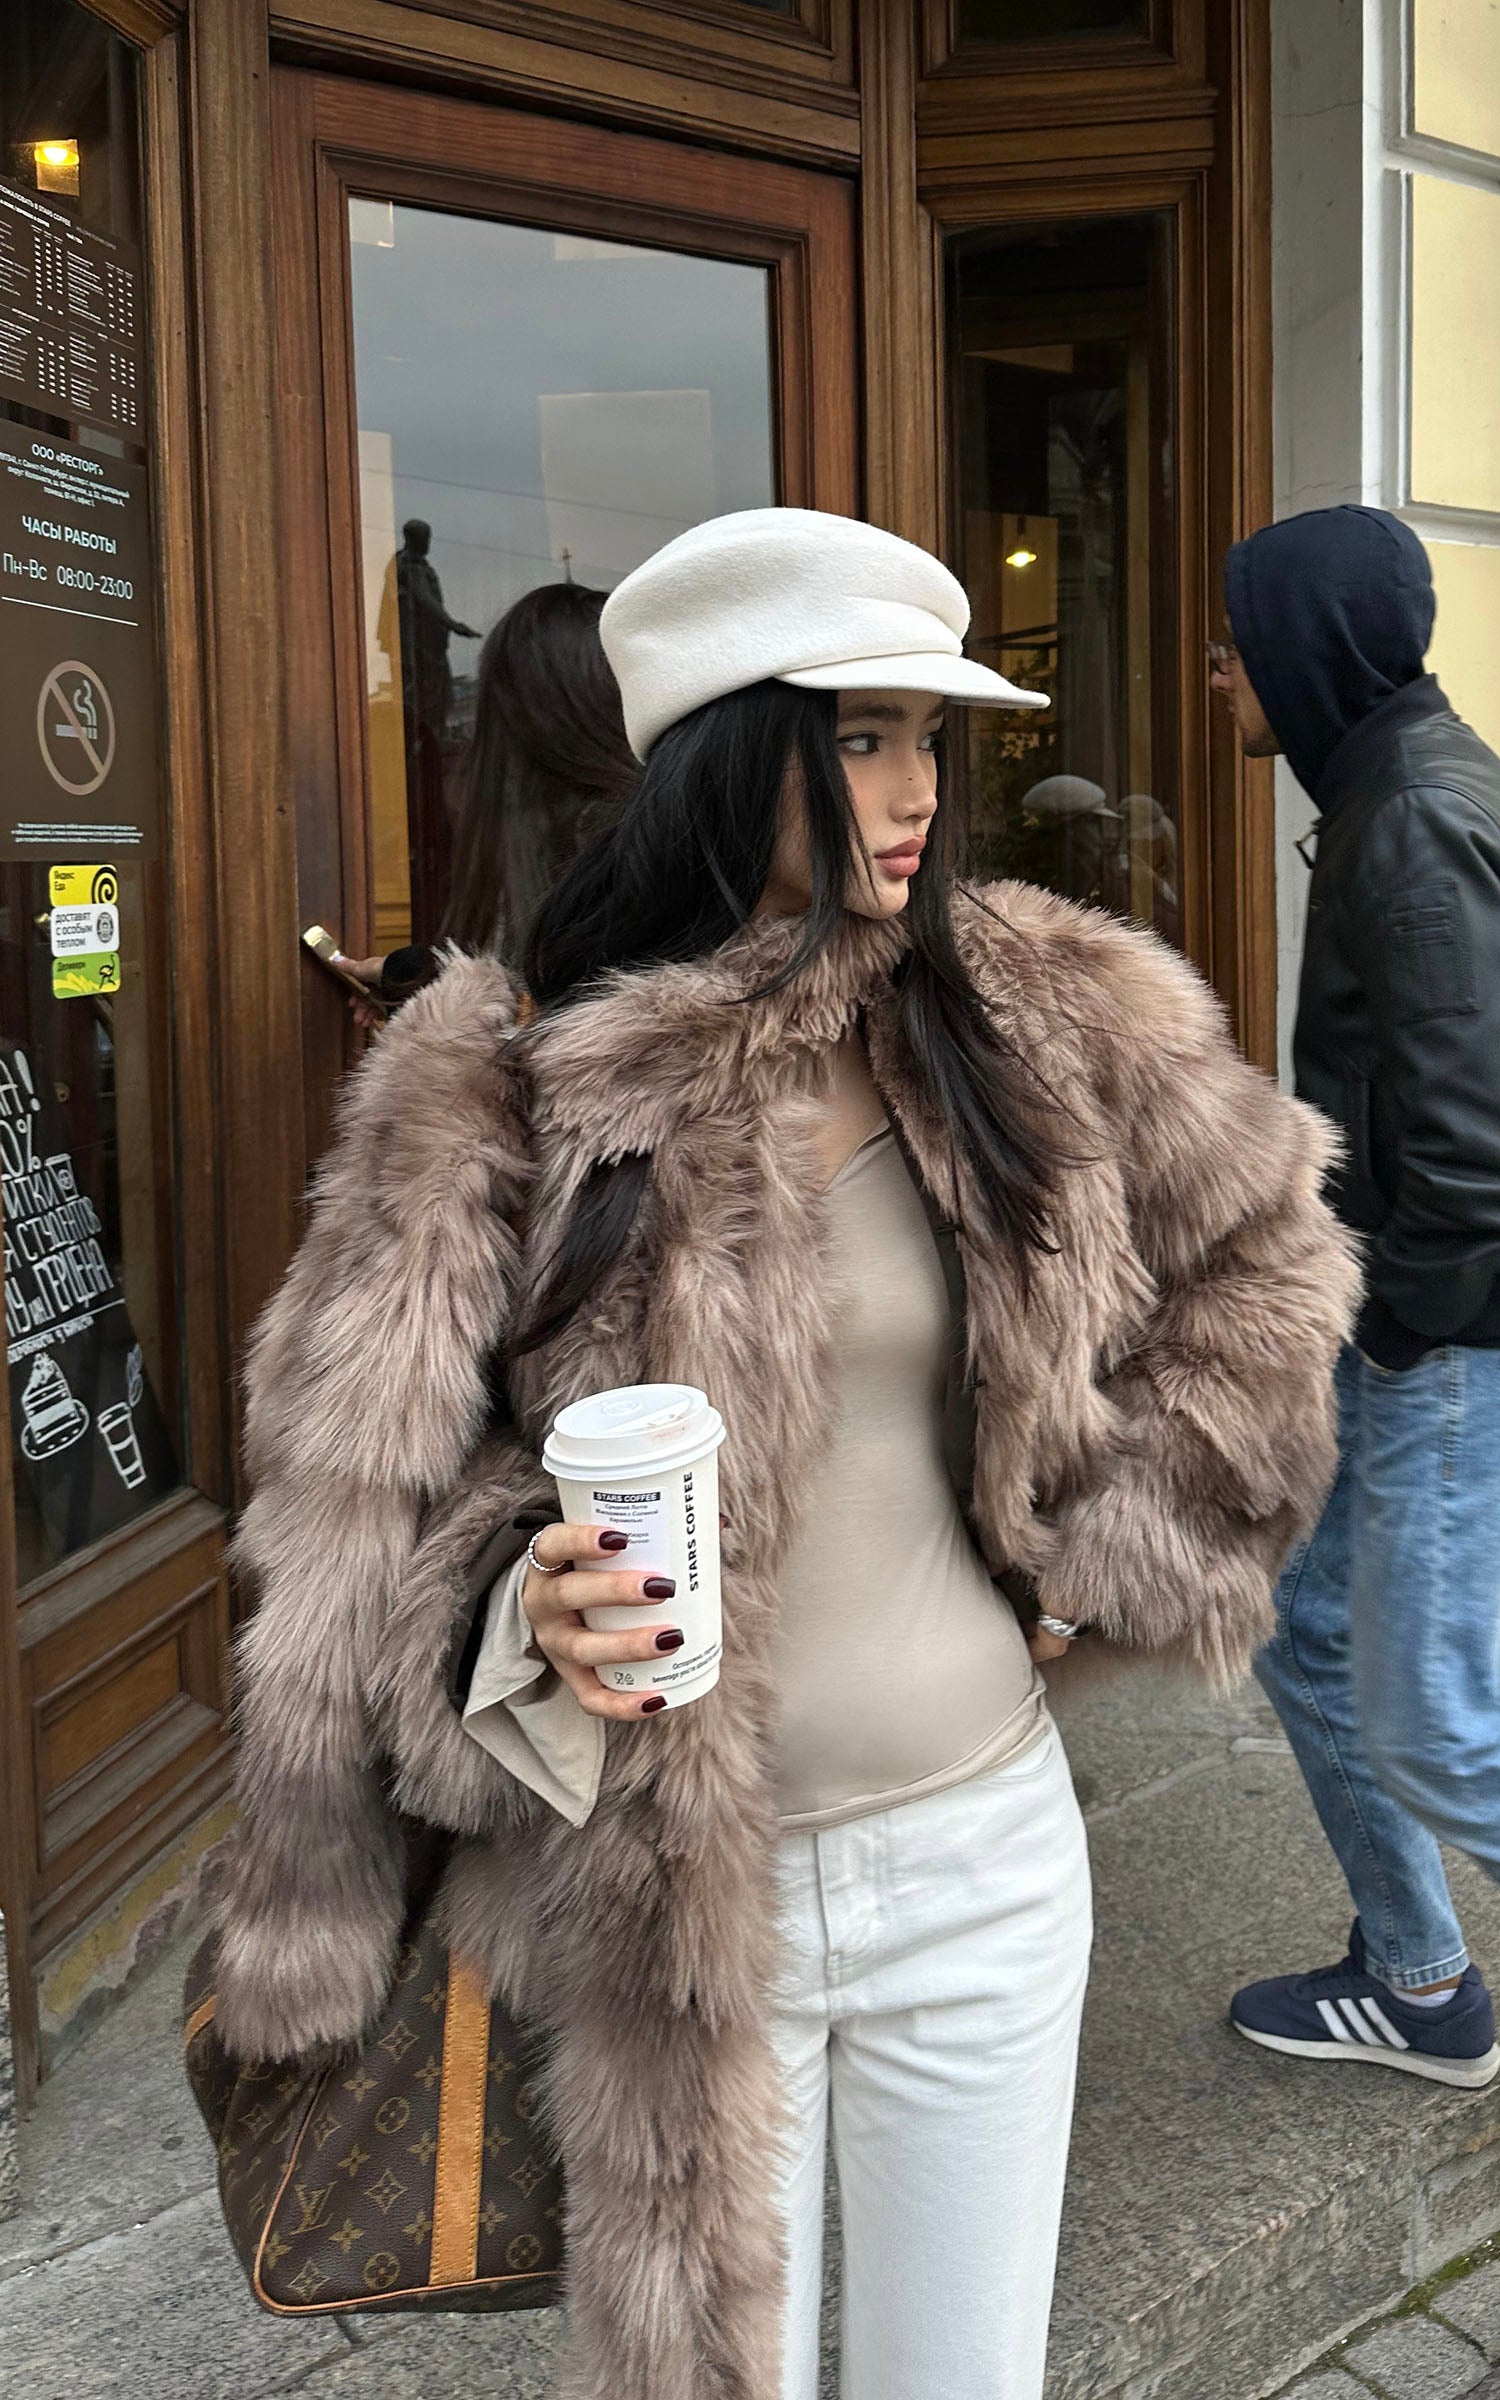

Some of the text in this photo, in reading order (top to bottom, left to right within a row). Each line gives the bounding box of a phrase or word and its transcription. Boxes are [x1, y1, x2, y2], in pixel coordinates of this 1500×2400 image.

[32, 443, 55, 461] ООО
[56, 452, 104, 476] «РЕСТОРГ»
[22, 515, 117, 554] ЧАСЫ РАБОТЫ
[3, 552, 134, 600] Пн-Вс 08:00-23:00
[62, 923, 93, 935] особым
[596, 1492, 657, 1502] STARS COFFEE
[683, 1471, 699, 1592] STARS COFFEE
